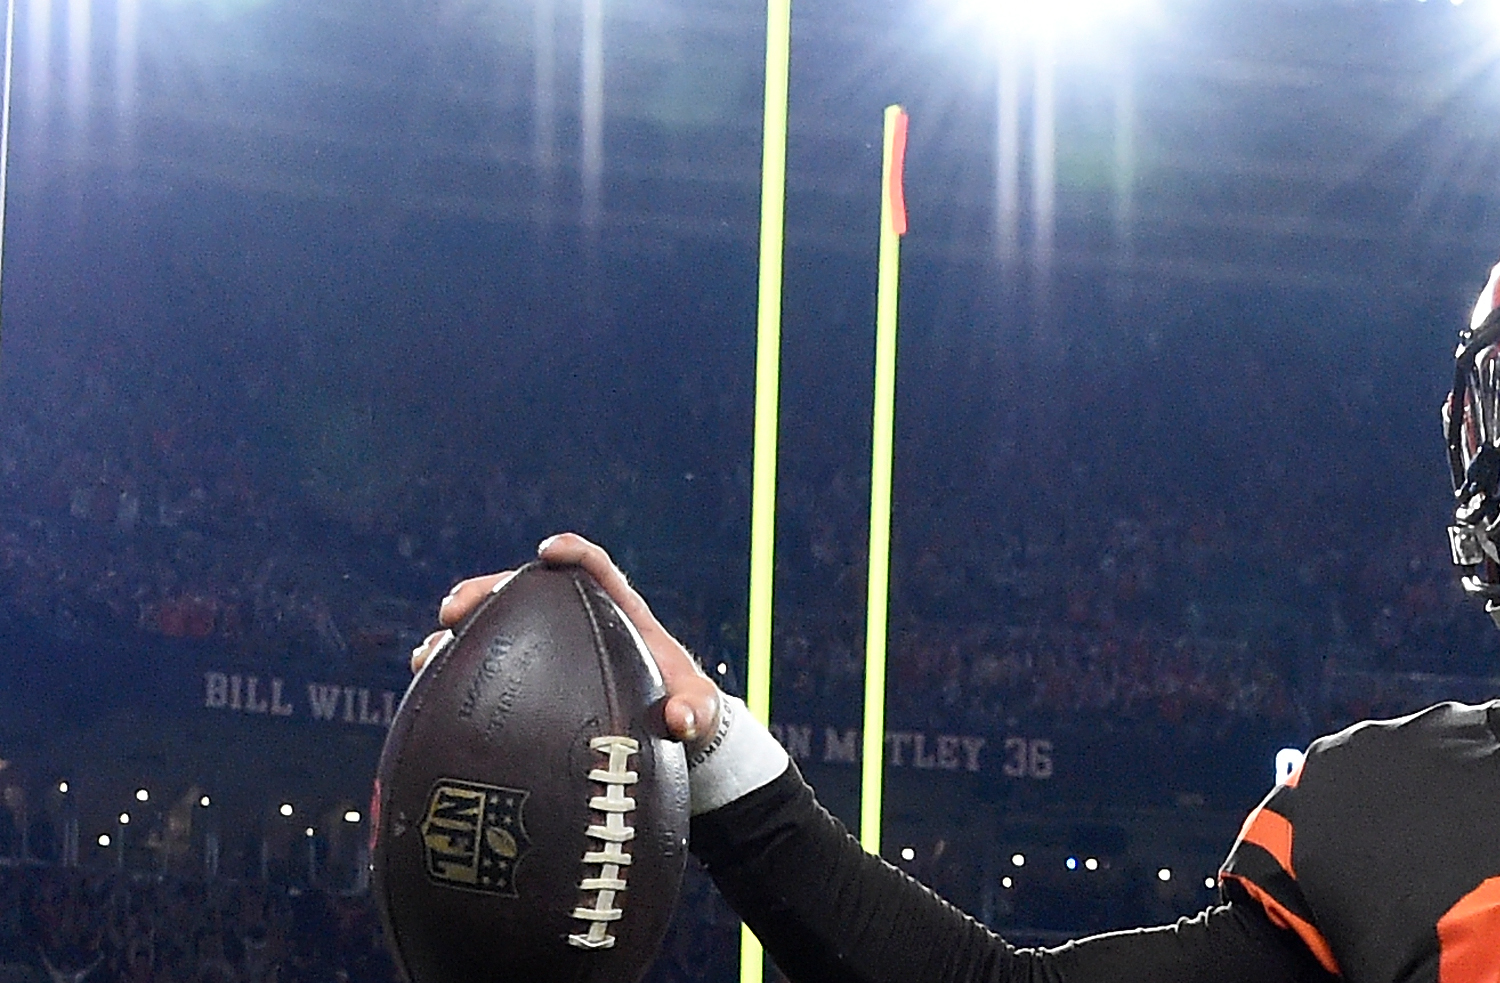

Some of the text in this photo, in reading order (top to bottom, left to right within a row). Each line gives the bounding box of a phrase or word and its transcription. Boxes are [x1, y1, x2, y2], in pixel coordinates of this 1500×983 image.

[204, 672, 294, 716] BILL
[823, 725, 985, 772] MTLEY
[1003, 737, 1054, 779] 36
[430, 793, 483, 885] NFL
